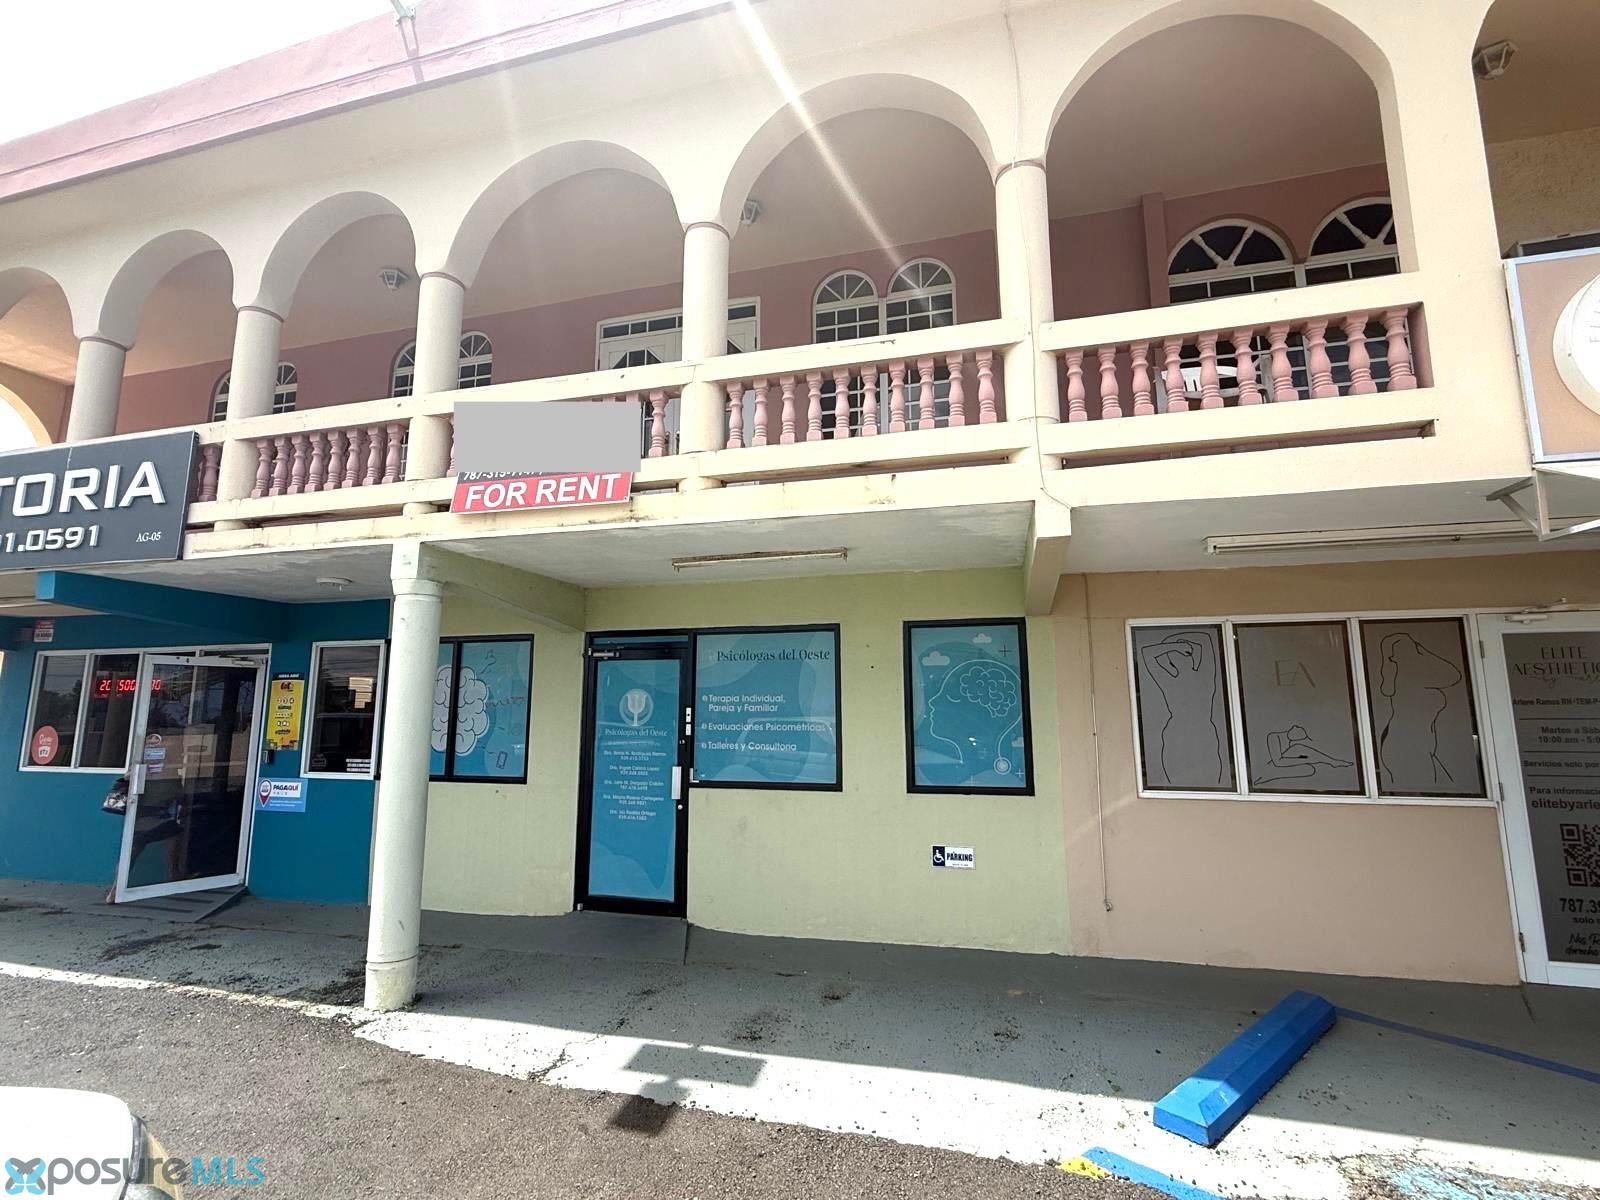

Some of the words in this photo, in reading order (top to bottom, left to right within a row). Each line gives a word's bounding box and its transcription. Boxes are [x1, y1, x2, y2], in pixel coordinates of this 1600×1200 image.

[465, 485, 527, 510] FOR
[535, 473, 621, 504] RENT
[0, 525, 99, 553] 1.0591
[136, 531, 162, 543] AG-05
[716, 650, 775, 663] Psicólogas
[778, 650, 795, 661] del
[799, 649, 831, 661] Oeste
[1541, 647, 1588, 659] ELITE
[709, 694, 740, 704] Terapia
[708, 704, 735, 712] Pareja
[744, 704, 778, 712] Familiar
[708, 723, 764, 731] Evaluaciones
[708, 741, 739, 750] Talleres
[741, 743, 746, 751] y
[1529, 786, 1551, 795] Para
[946, 852, 973, 862] PARKING
